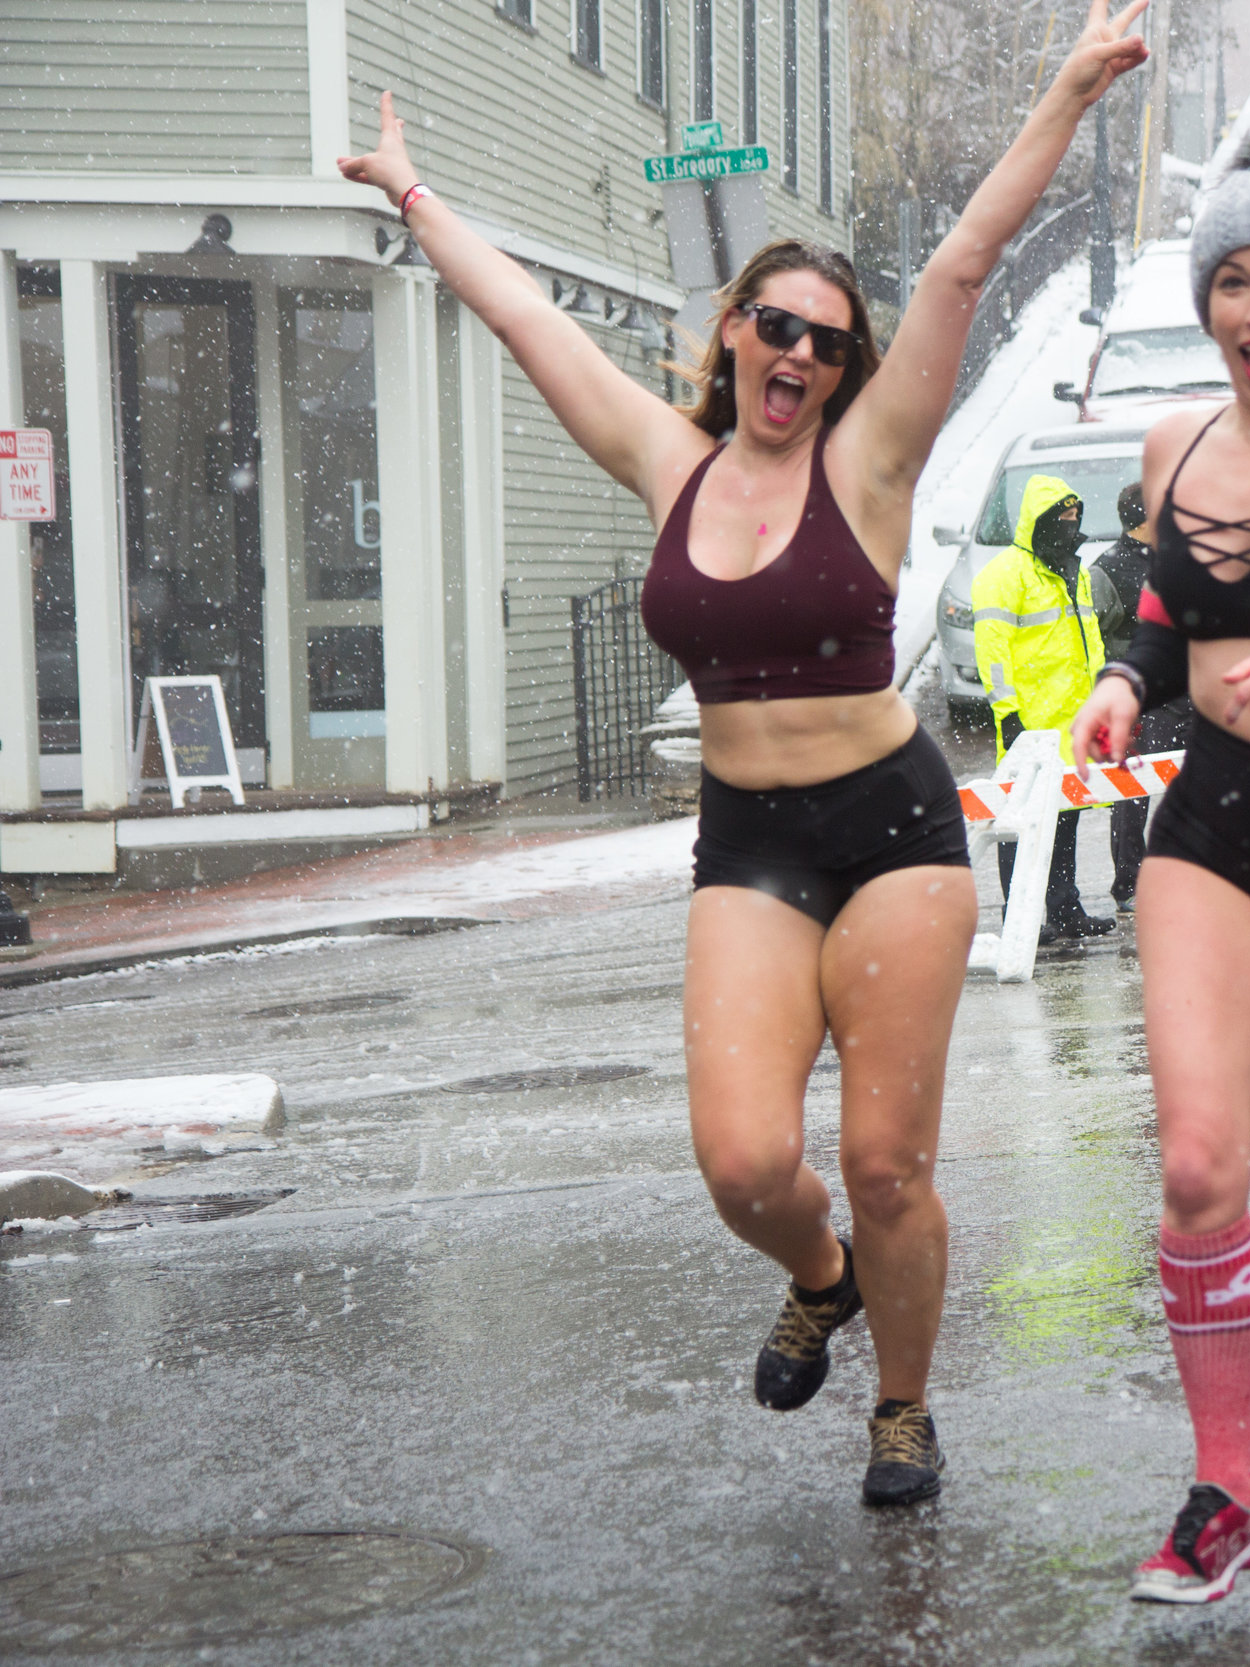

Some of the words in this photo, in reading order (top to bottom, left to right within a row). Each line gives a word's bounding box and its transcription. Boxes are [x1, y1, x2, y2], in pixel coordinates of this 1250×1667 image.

[673, 156, 732, 179] Gregory
[0, 436, 14, 455] NO
[10, 463, 38, 480] ANY
[9, 484, 43, 501] TIME
